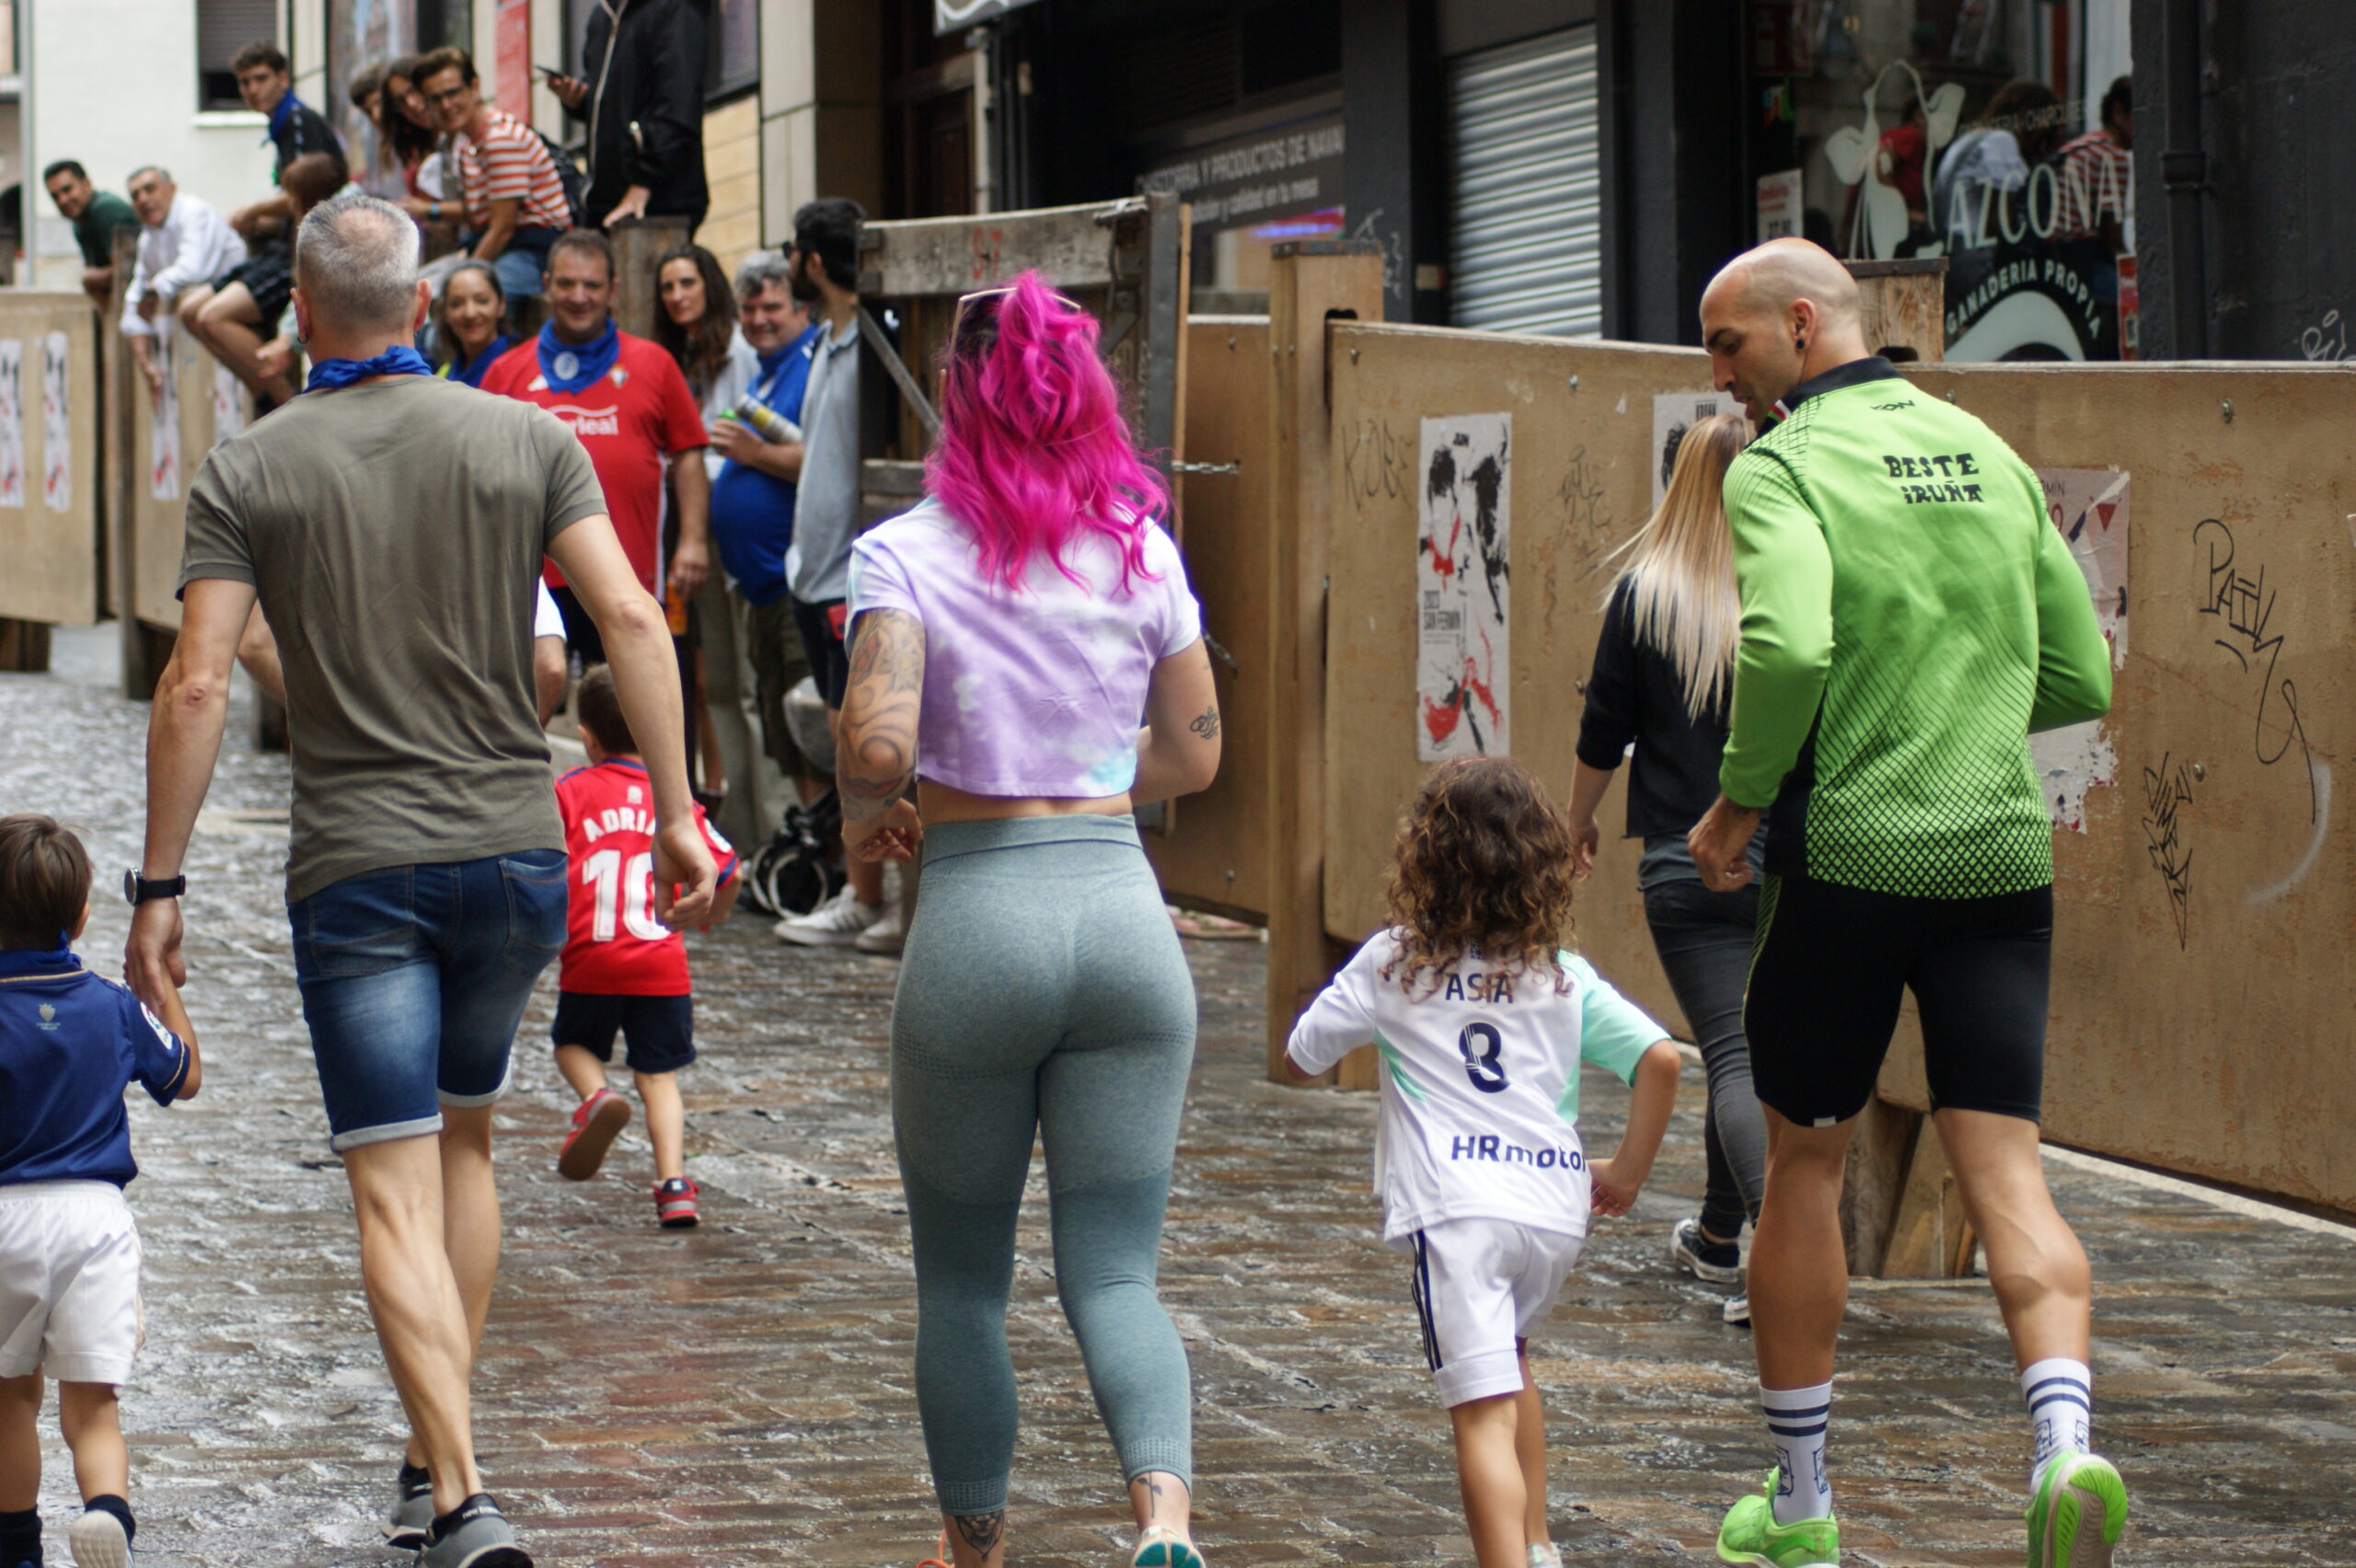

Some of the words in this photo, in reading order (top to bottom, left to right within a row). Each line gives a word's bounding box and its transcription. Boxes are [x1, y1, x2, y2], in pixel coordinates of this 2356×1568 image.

[1210, 139, 1286, 184] PRODUCTOS
[1946, 152, 2124, 253] AZCONA
[1946, 259, 2038, 335] GANADERIA
[2044, 259, 2101, 340] PROPIA
[1883, 453, 1980, 478] BESTE
[582, 848, 671, 942] 10
[1445, 973, 1514, 1004] ASIA
[1459, 1021, 1511, 1093] 8
